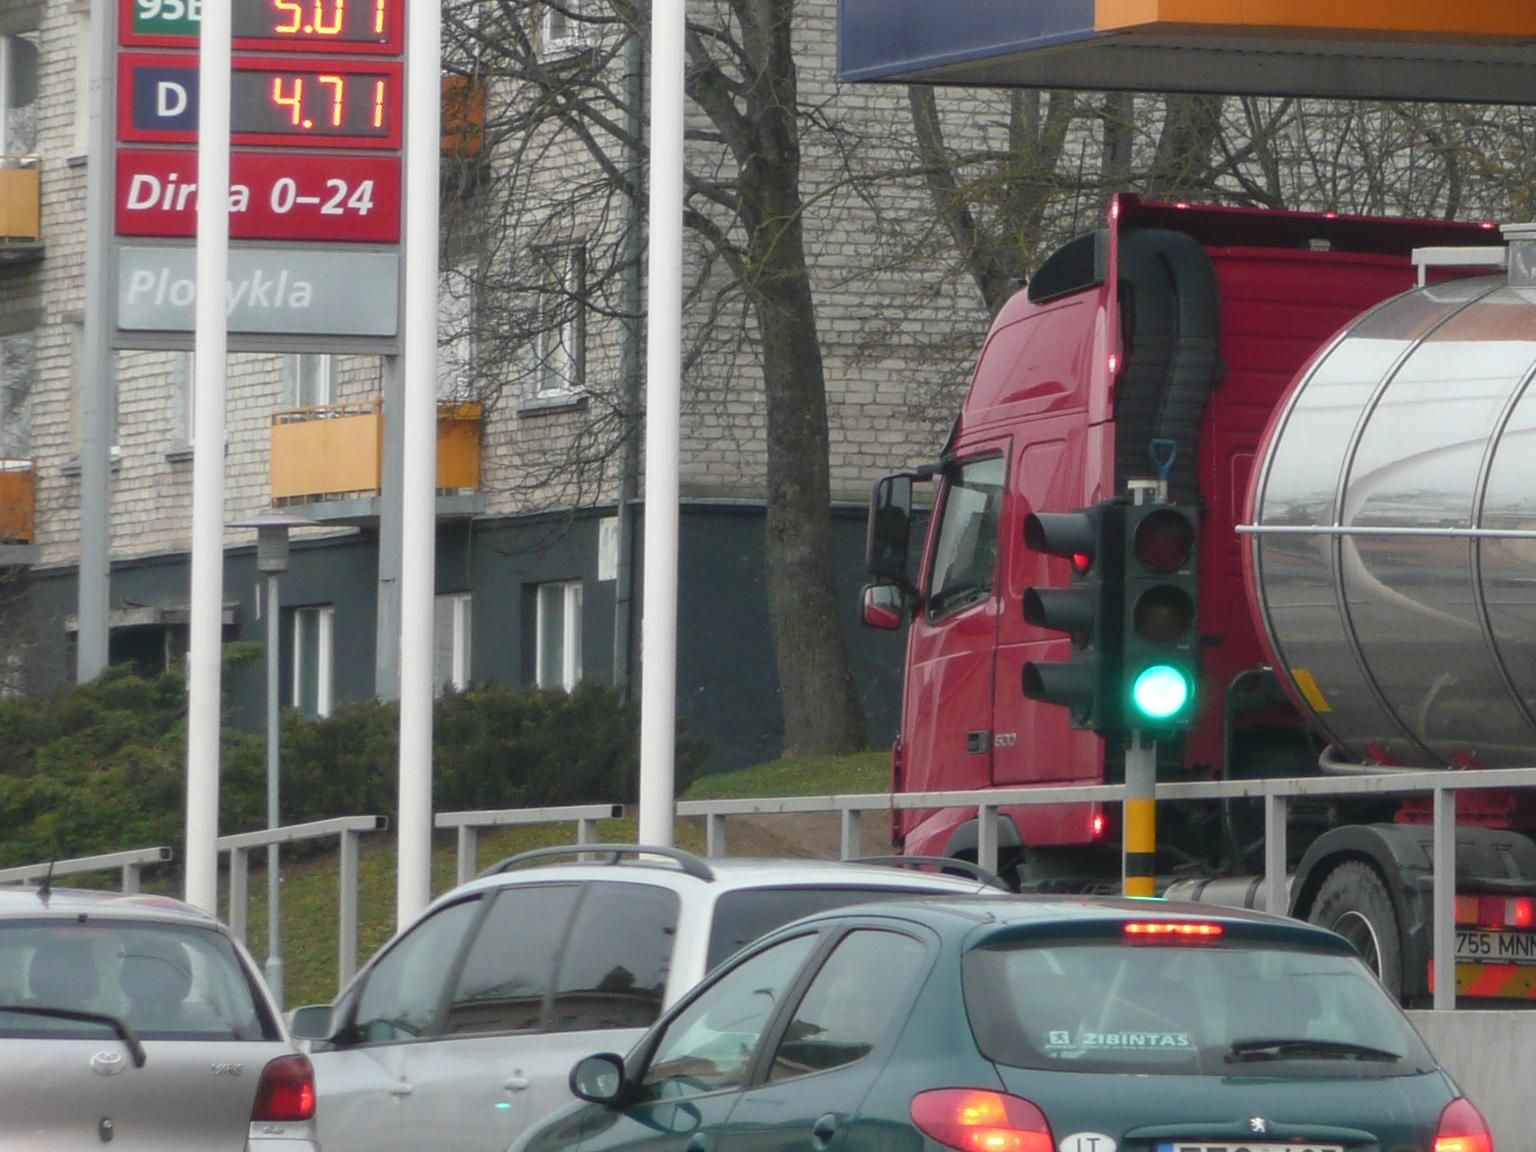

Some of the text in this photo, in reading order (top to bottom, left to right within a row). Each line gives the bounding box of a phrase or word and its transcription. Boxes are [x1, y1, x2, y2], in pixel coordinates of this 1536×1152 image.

[157, 75, 385, 129] D 4.71
[127, 173, 250, 212] Dira
[128, 268, 313, 316] Ploykla
[1456, 933, 1490, 954] 755
